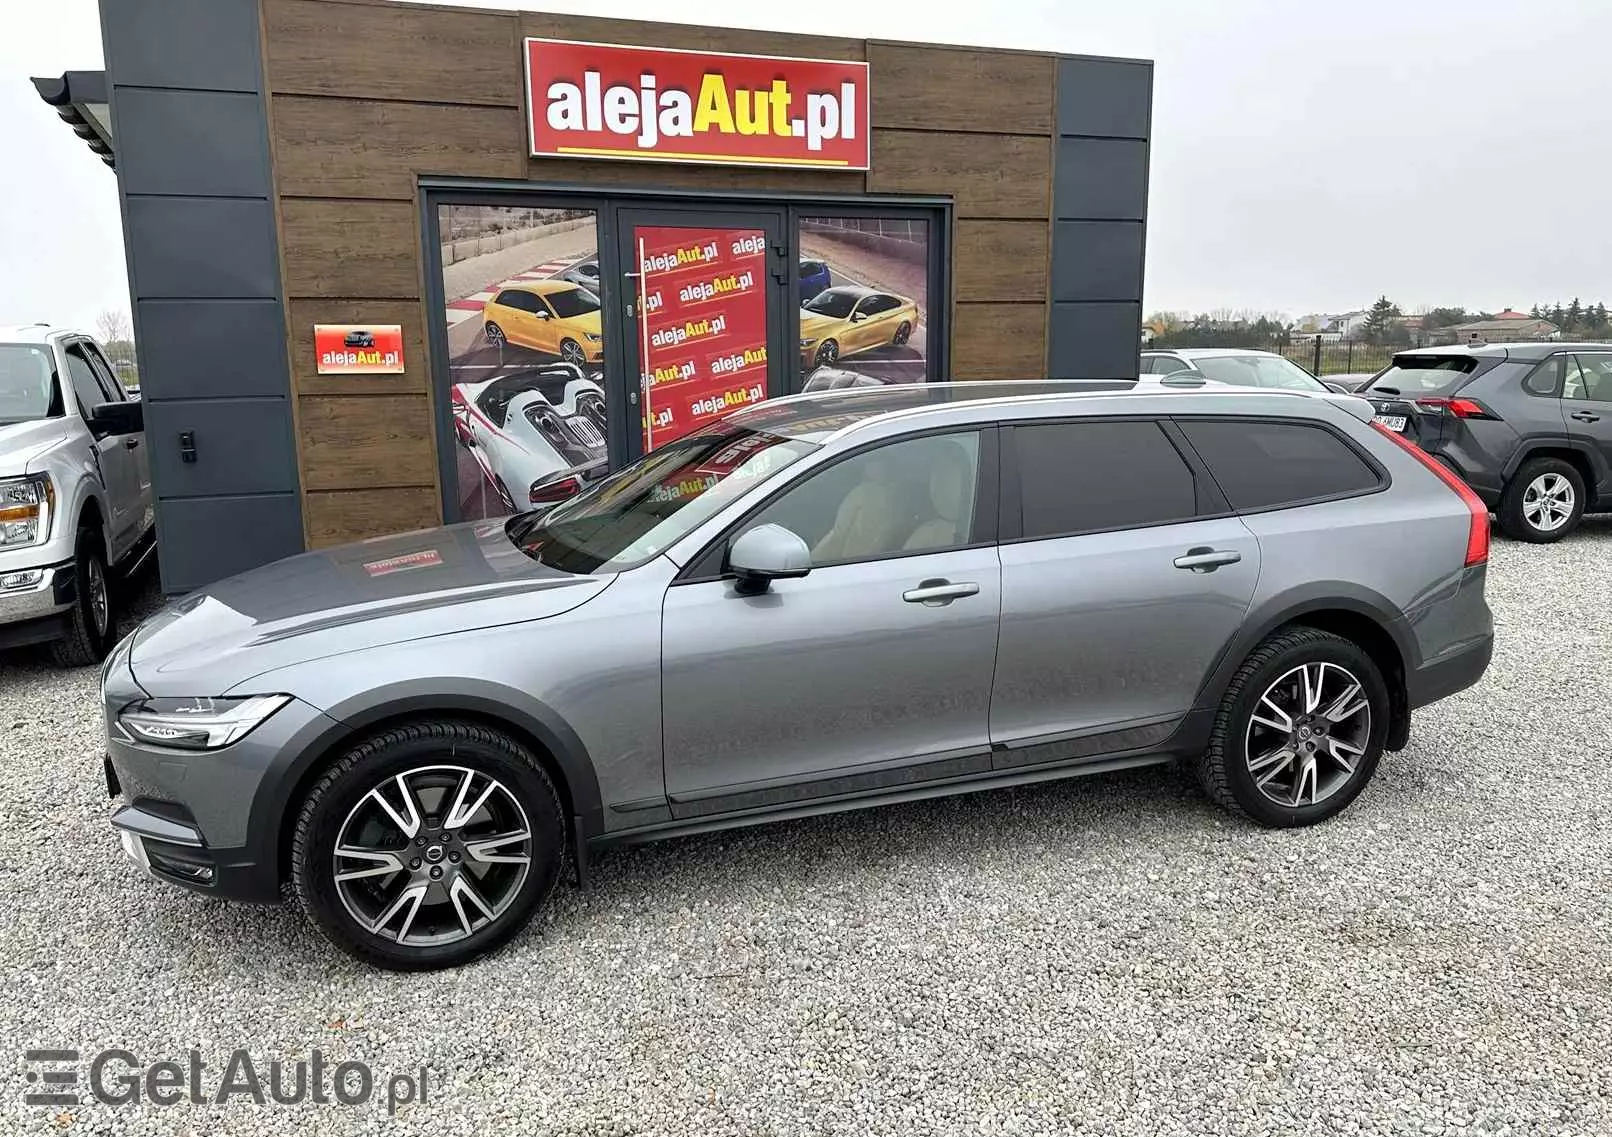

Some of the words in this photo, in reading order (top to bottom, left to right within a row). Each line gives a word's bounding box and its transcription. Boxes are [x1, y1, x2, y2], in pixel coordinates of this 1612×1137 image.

[547, 71, 856, 150] alejaAut.pl
[644, 242, 718, 272] alejaAut.pl
[679, 271, 753, 301] alejaAut.pl
[651, 315, 726, 346] alejaAut.pl
[322, 350, 399, 366] alejaAut.pl
[691, 383, 764, 415] alejaAut.pl
